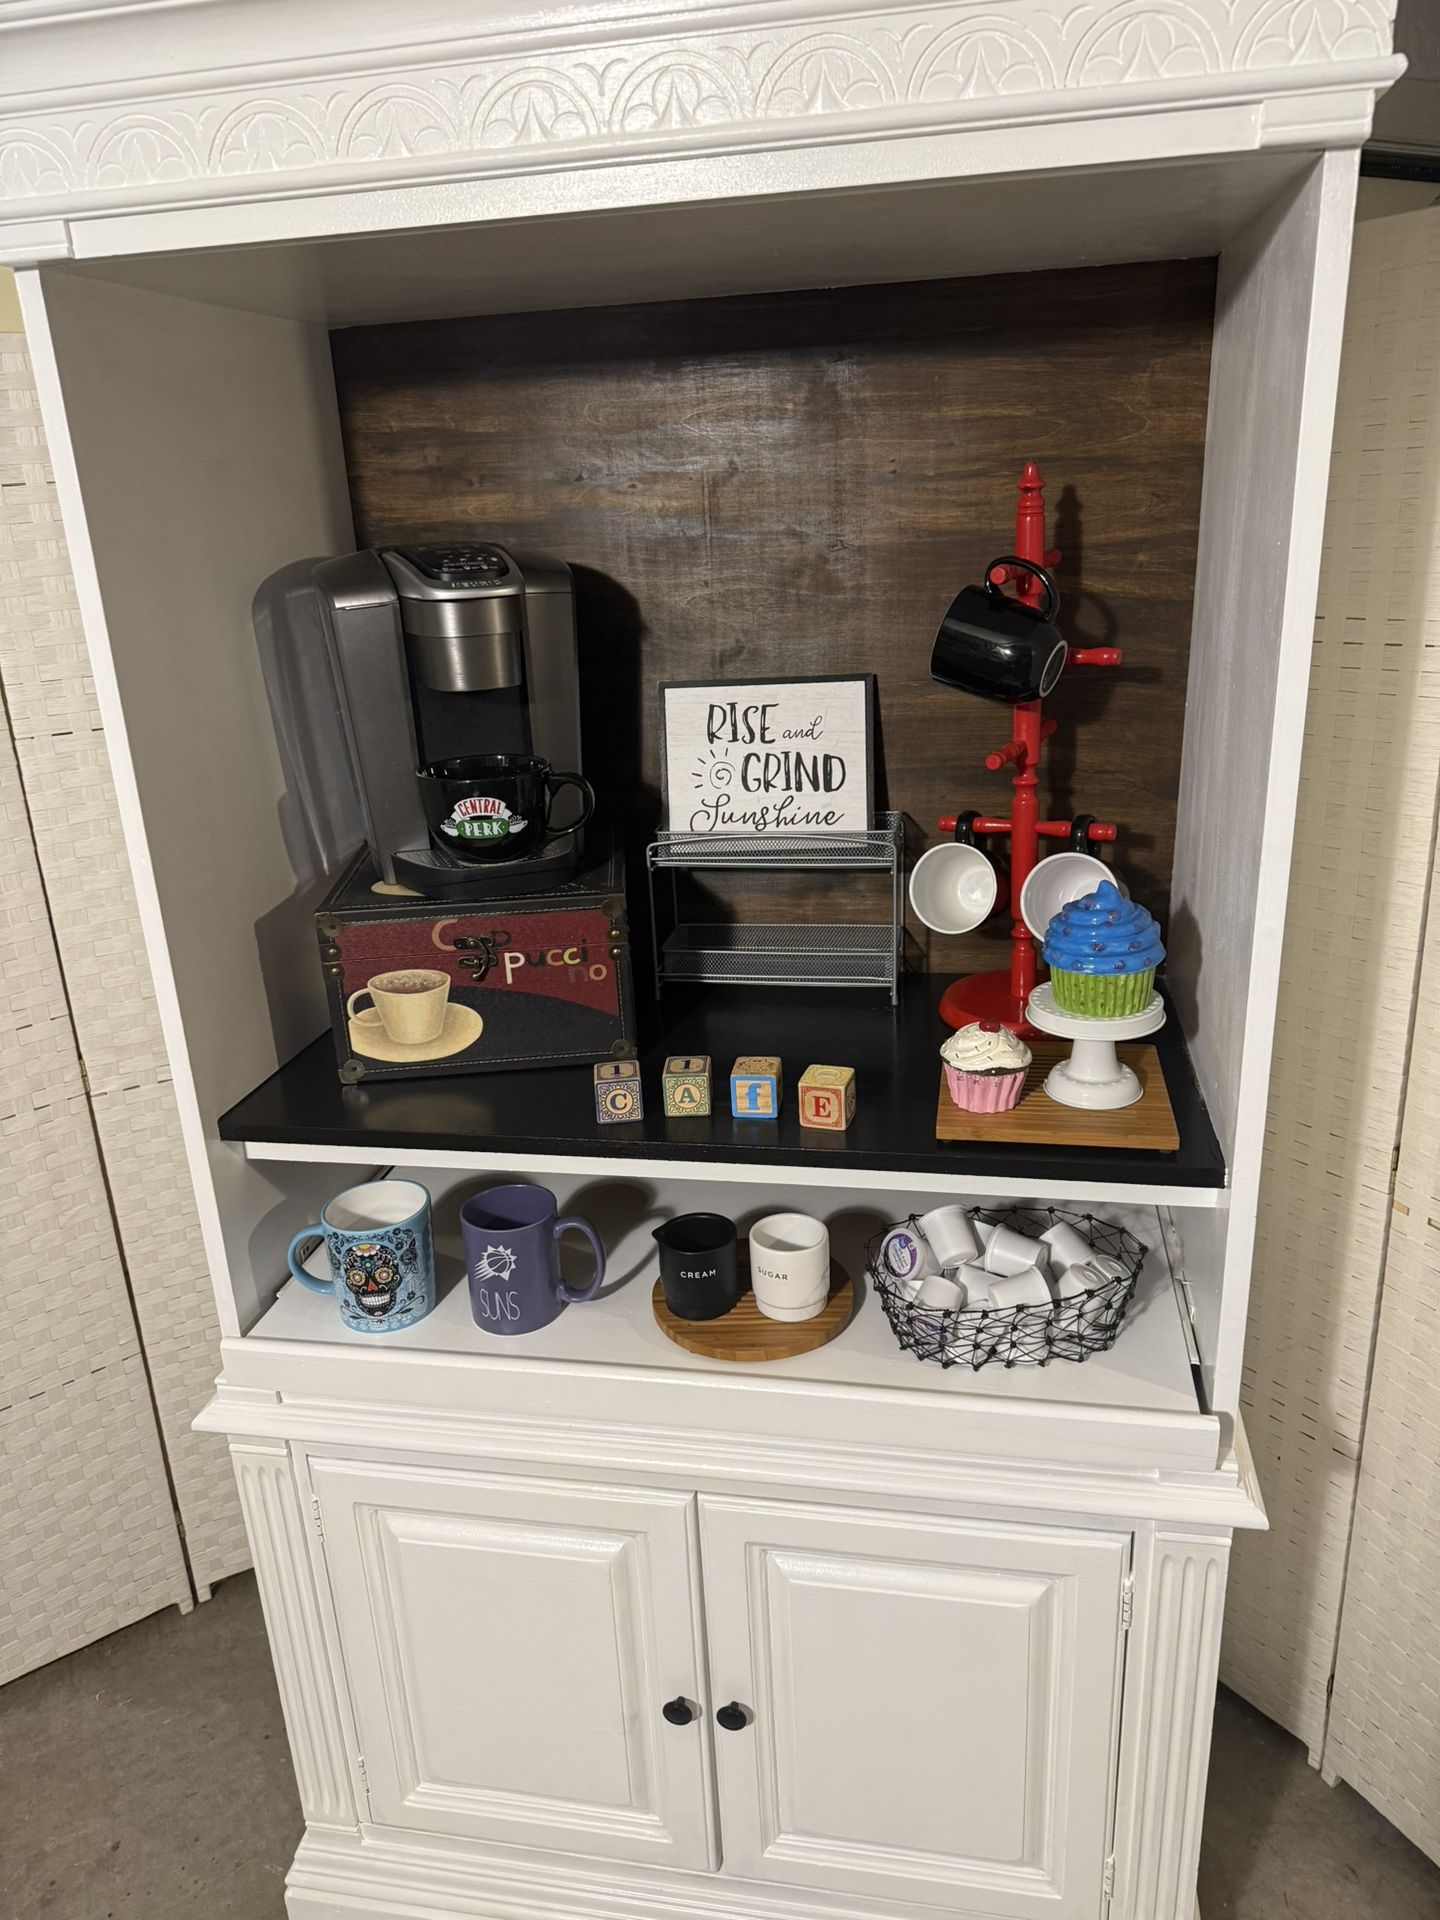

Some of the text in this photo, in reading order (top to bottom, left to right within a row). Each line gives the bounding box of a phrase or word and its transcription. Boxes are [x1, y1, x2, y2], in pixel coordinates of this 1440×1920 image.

[706, 701, 824, 744] RISE and
[740, 751, 847, 793] GRIND
[457, 798, 502, 817] CENTRAL
[689, 793, 845, 832] Sunshine
[463, 821, 504, 837] PERK
[609, 1063, 621, 1078] 1
[680, 1059, 692, 1071] 1
[609, 1092, 628, 1111] C
[677, 1086, 698, 1104] A
[812, 1095, 831, 1118] E
[680, 1268, 717, 1279] CREAM
[757, 1265, 789, 1281] SUGAR
[479, 1287, 521, 1321] SUNS
